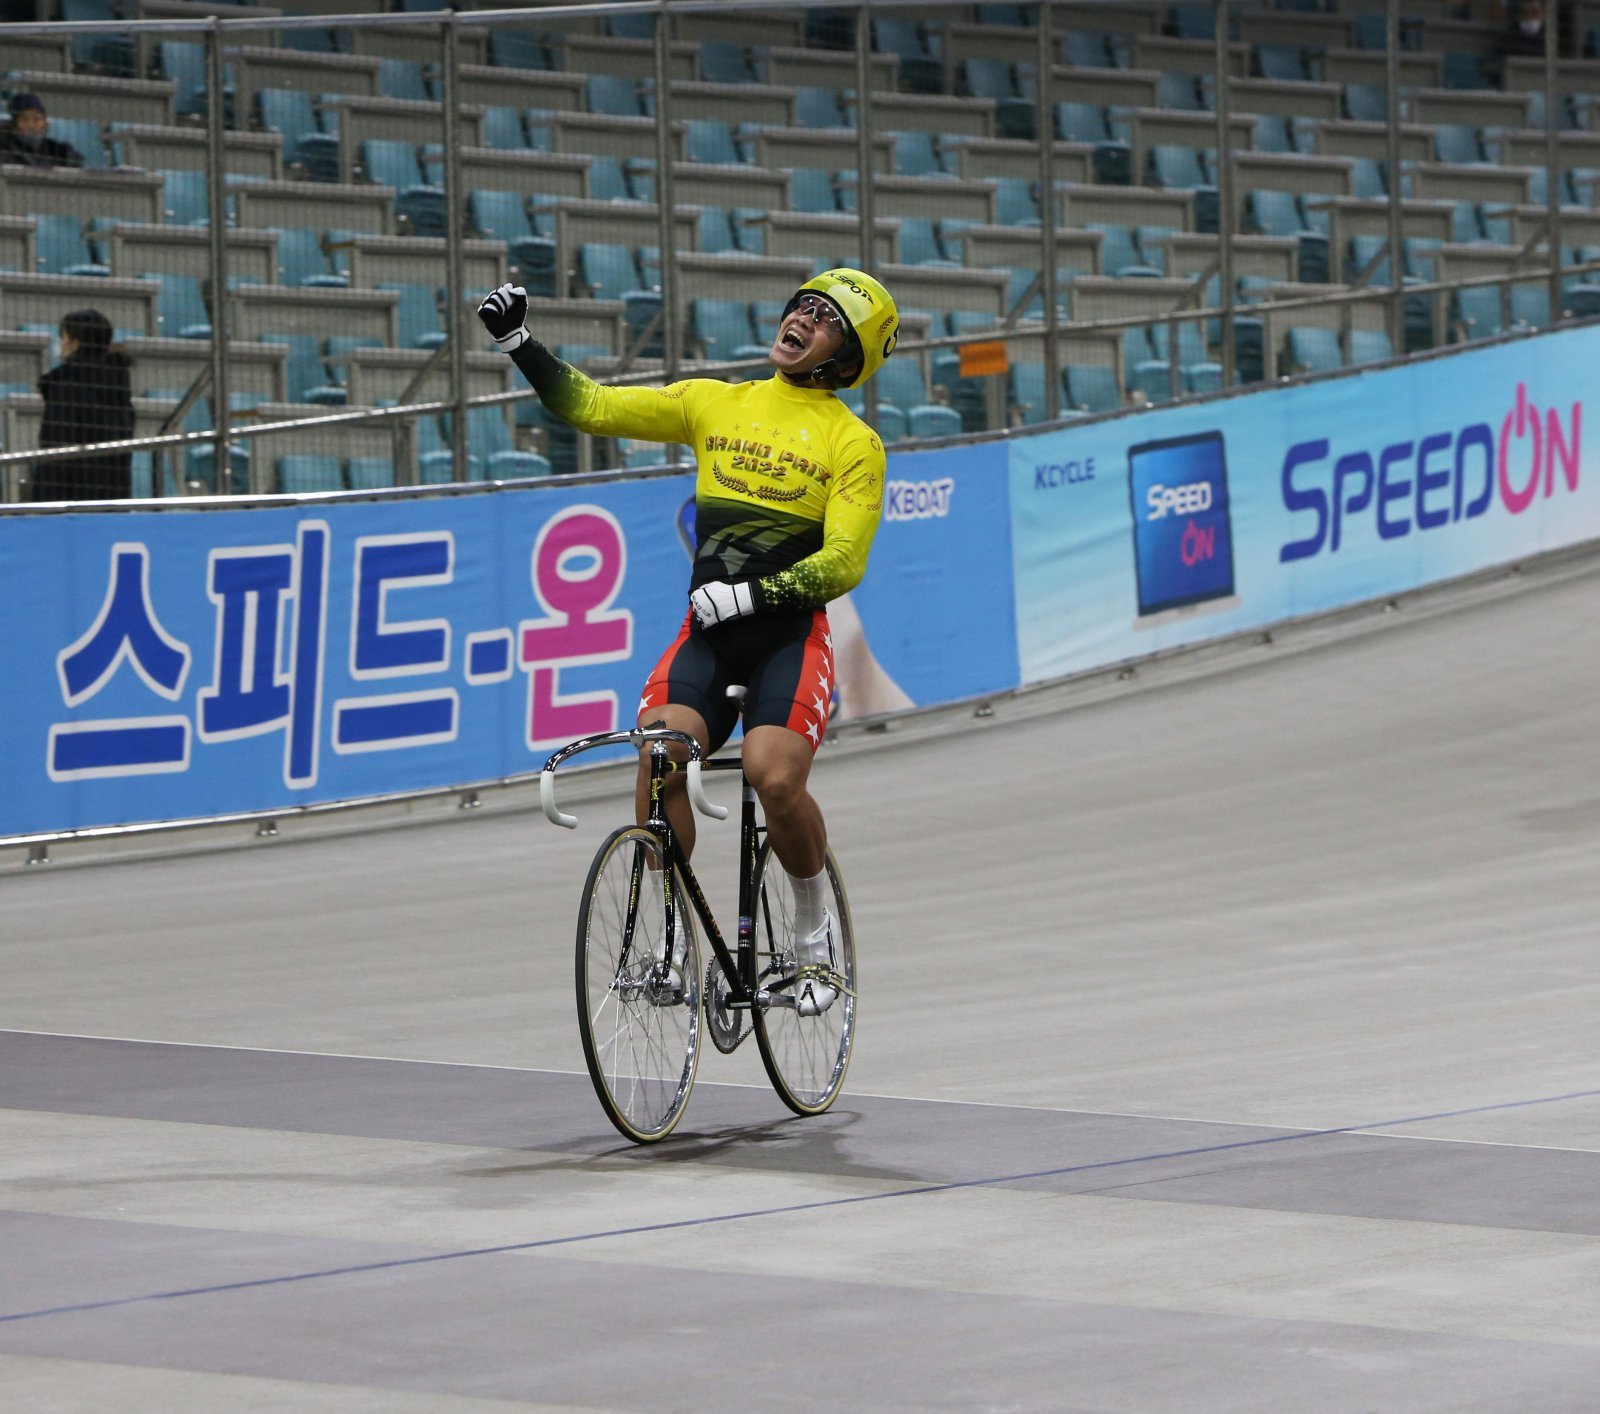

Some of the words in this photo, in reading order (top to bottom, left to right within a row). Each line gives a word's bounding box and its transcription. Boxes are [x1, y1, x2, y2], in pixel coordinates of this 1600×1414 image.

[706, 435, 772, 458] GRAND
[778, 450, 832, 487] PRIX
[731, 455, 787, 482] 2022
[1035, 457, 1096, 490] KCYCLE
[886, 479, 953, 520] KBOAT
[1147, 481, 1212, 521] SPEED
[1181, 519, 1214, 567] ON
